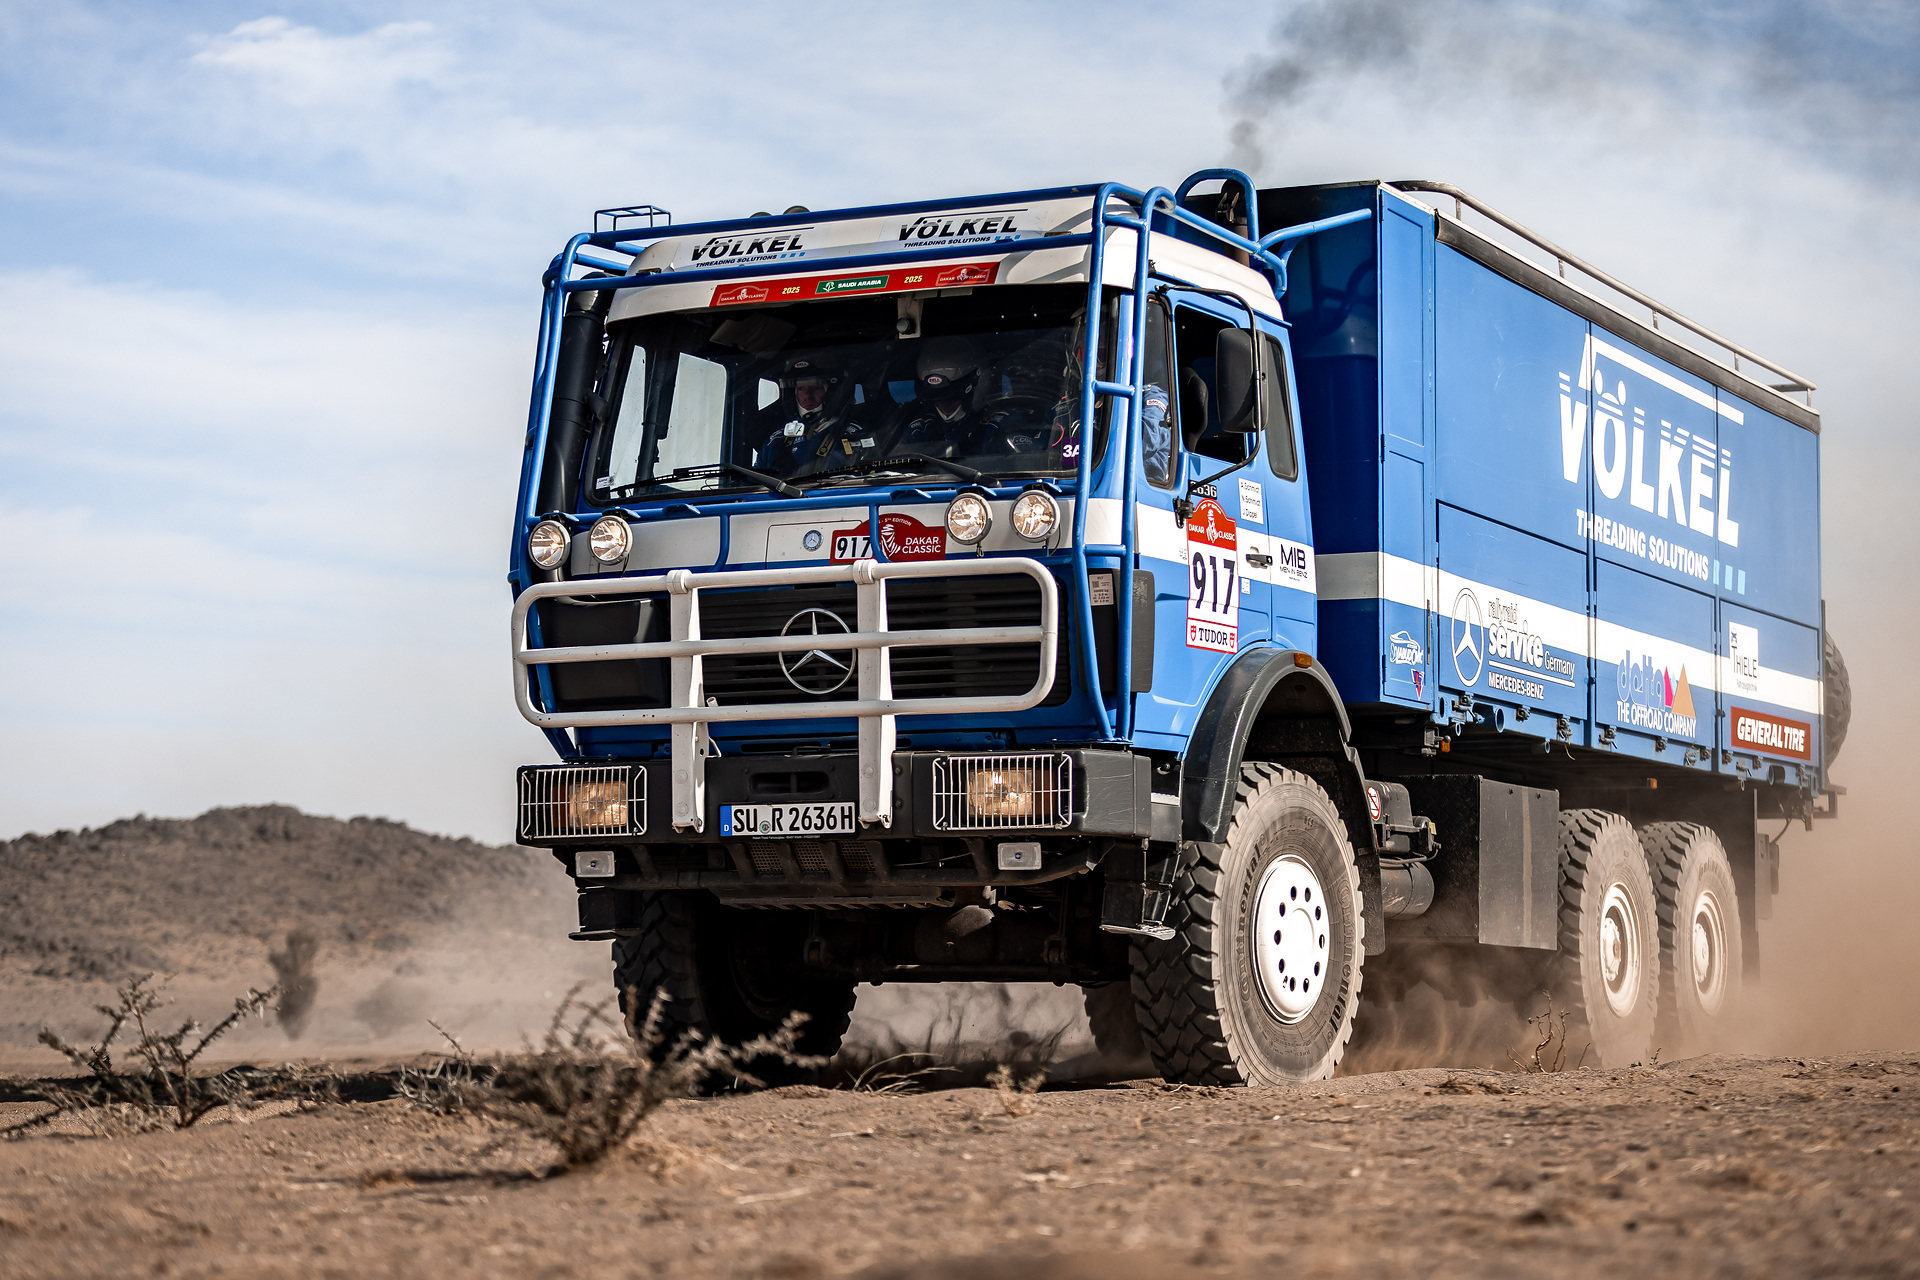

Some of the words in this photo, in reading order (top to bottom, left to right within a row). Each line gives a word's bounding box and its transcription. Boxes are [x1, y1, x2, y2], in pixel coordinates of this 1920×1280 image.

[899, 216, 1018, 241] VÖLKEL
[691, 234, 804, 261] VÖLKEL
[904, 240, 946, 248] THREADING
[947, 236, 991, 244] SOLUTIONS
[695, 258, 736, 267] THREADING
[737, 254, 777, 263] SOLUTIONS
[782, 286, 801, 295] 2025
[837, 281, 857, 289] SAUDI
[857, 279, 882, 287] ARABIA
[904, 275, 923, 283] 2025
[1558, 369, 1739, 548] VÖLKEL
[892, 517, 912, 527] EDITION
[1188, 523, 1206, 535] DAKAR
[1218, 530, 1236, 542] CLASSIC
[837, 536, 871, 559] 917
[902, 545, 941, 554] CLASSIC
[905, 536, 939, 545] DAKAR
[1576, 508, 1646, 558] THREADING
[1648, 535, 1709, 581] SOLUTIONS
[1280, 543, 1306, 570] MIB
[1192, 551, 1236, 615] 917
[1198, 628, 1228, 646] TUDOR
[1488, 619, 1544, 668] service
[1544, 649, 1576, 681] Germany
[1488, 670, 1545, 700] MERCEDES-BENZ
[1616, 700, 1630, 724] THE
[1630, 704, 1663, 731] OFFROAD
[1663, 711, 1697, 738] COMPANY
[1737, 716, 1783, 749] GENERAL
[1783, 725, 1805, 753] TIRE
[733, 808, 758, 833] SU
[771, 807, 783, 832] R
